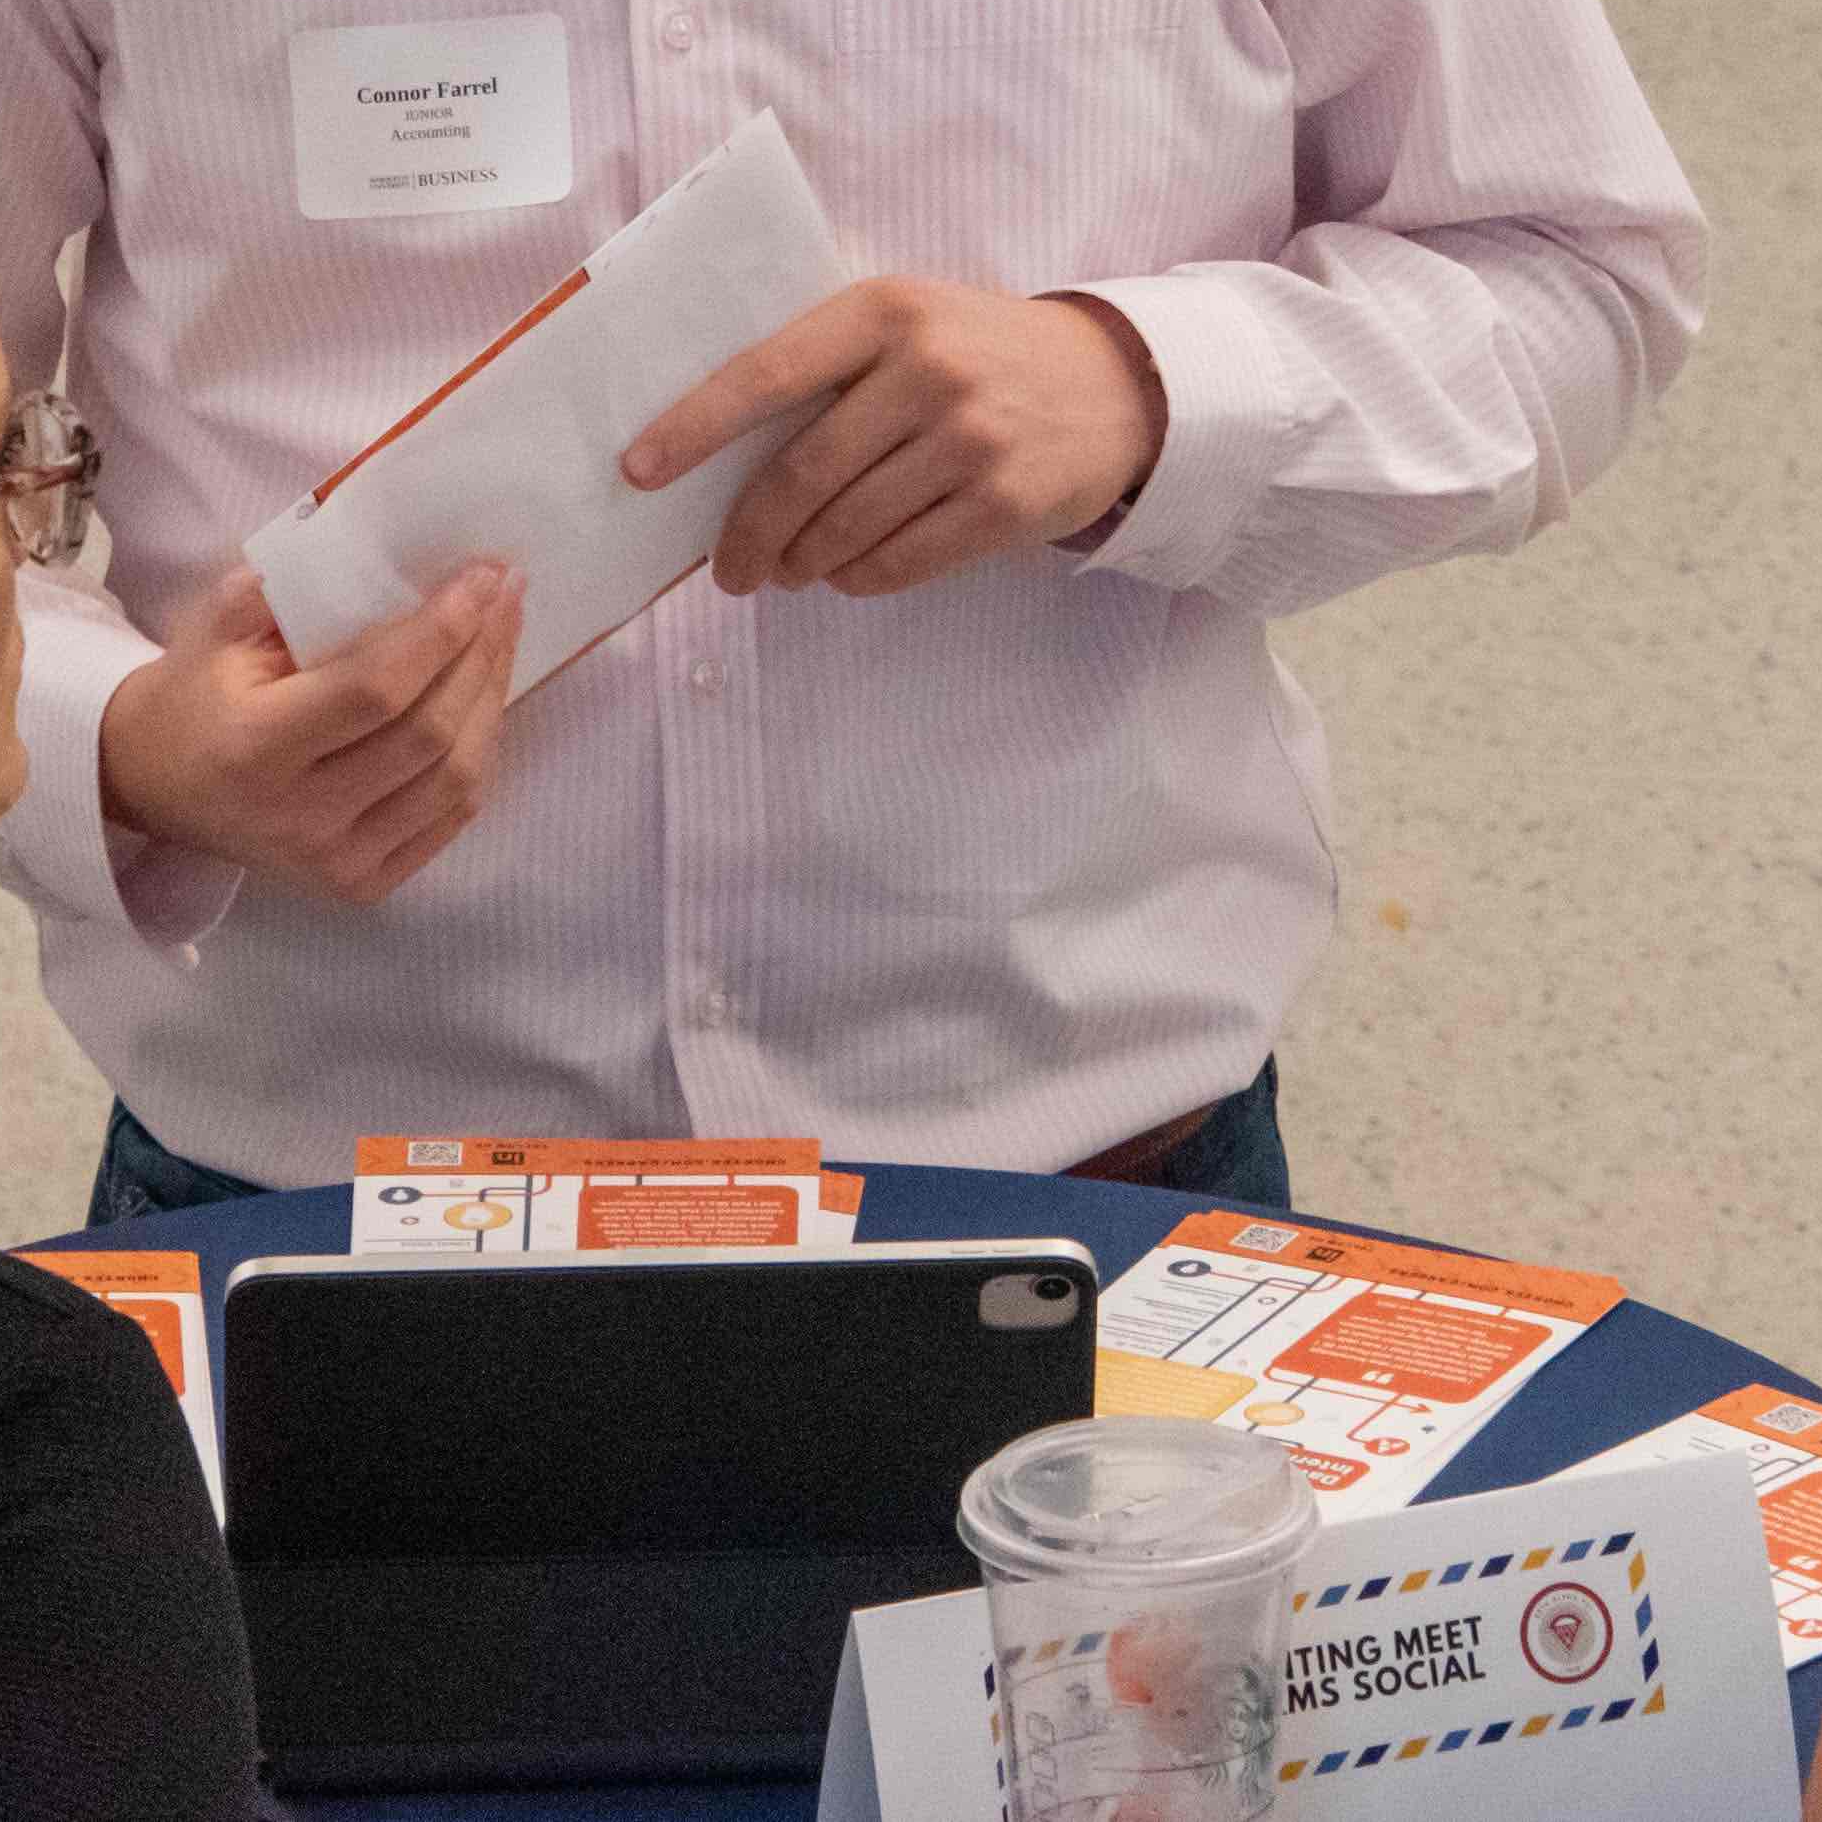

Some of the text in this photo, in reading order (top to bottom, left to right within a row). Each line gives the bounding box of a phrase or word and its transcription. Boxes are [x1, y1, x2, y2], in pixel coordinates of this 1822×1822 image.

[357, 77, 498, 104] Connor Farrel
[403, 106, 453, 121] JUNIOR
[391, 125, 471, 142] Accounting
[417, 169, 499, 187] BUSINESS
[1394, 1615, 1482, 1660] MEET
[1282, 1651, 1486, 1716] MS SOCIAL
